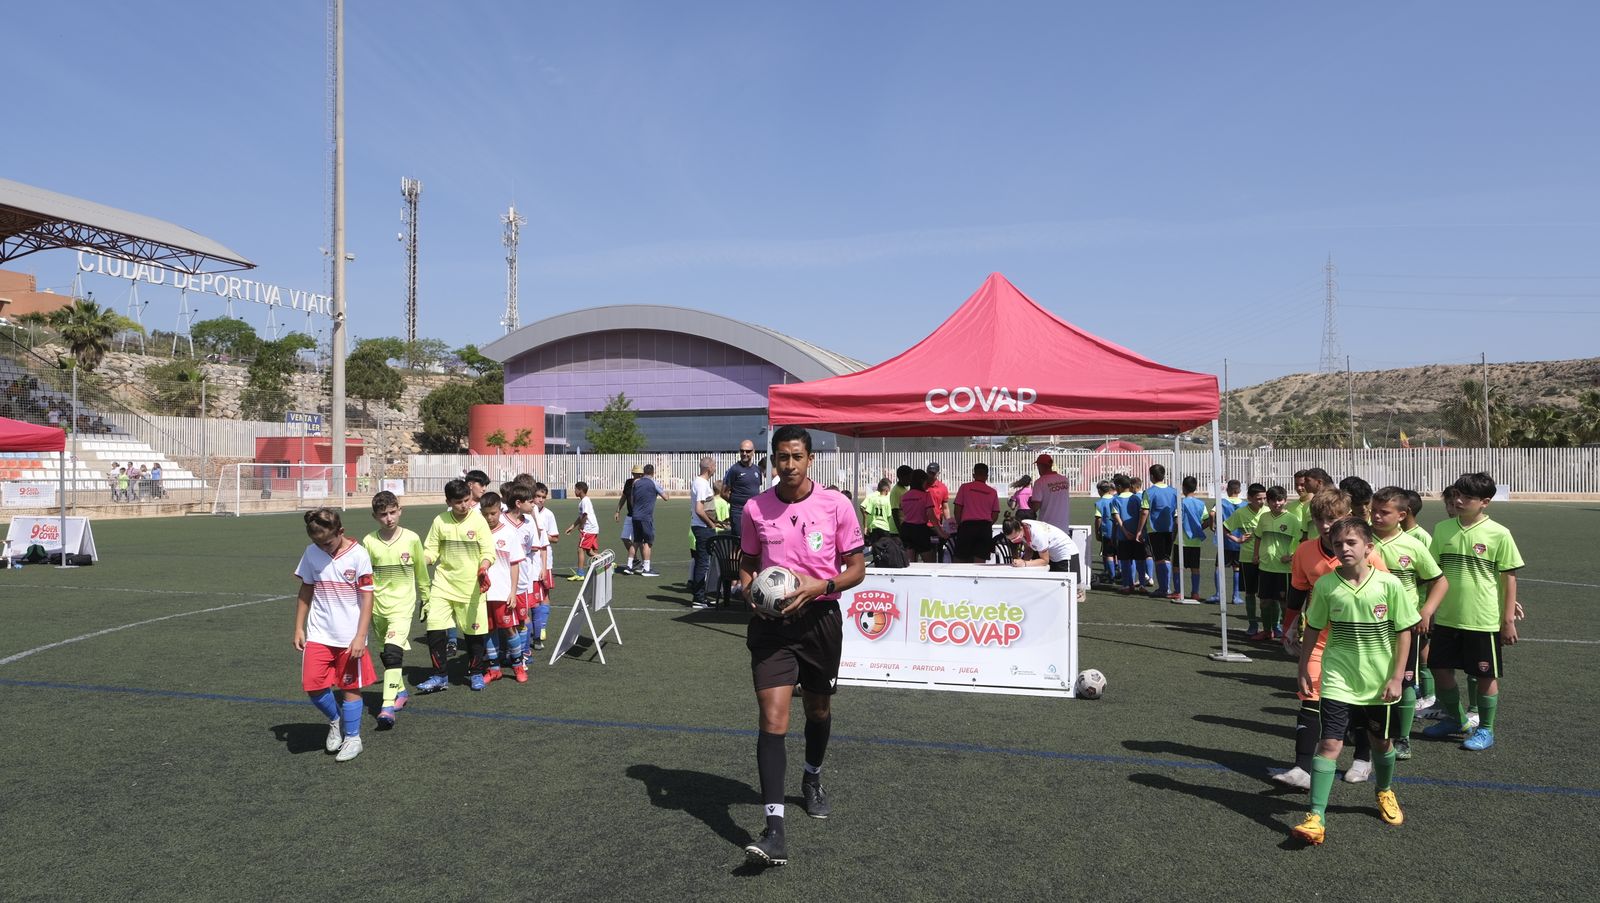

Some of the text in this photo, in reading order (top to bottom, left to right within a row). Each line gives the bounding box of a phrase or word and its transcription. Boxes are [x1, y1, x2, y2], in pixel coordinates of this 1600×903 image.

[78, 245, 165, 285] CIUDAD
[174, 265, 282, 307] DEPORTIVA
[925, 386, 1037, 414] COVAP
[875, 507, 883, 516] 11
[31, 524, 40, 539] 9
[39, 531, 59, 540] COVAP
[42, 524, 57, 532] COPA
[855, 601, 893, 612] COVAP
[920, 598, 1023, 622] Muévete
[928, 620, 1021, 646] COVAP
